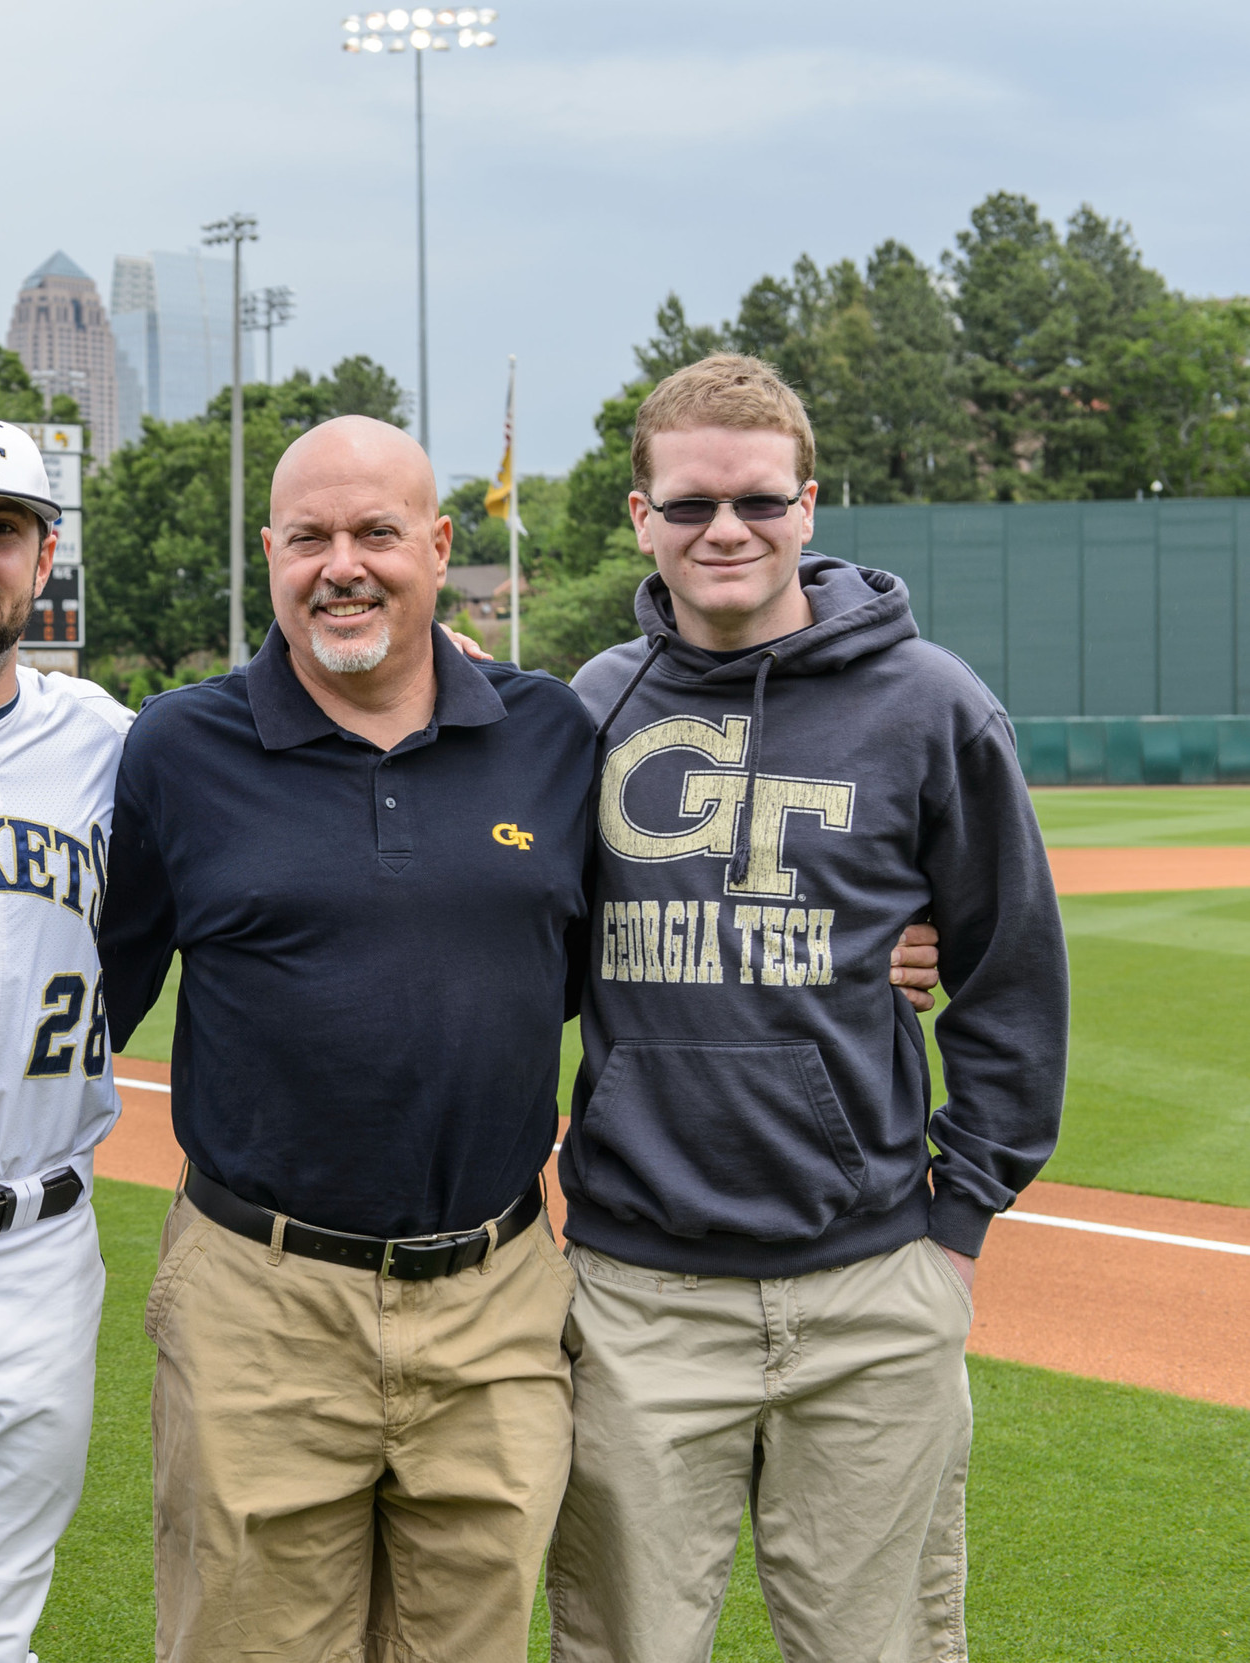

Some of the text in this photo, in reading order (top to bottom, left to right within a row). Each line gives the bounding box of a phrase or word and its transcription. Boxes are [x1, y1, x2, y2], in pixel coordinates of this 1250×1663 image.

[492, 823, 534, 850] GT
[599, 714, 856, 900] GT
[601, 900, 835, 987] GEORGIA TECH
[23, 971, 106, 1080] 28
